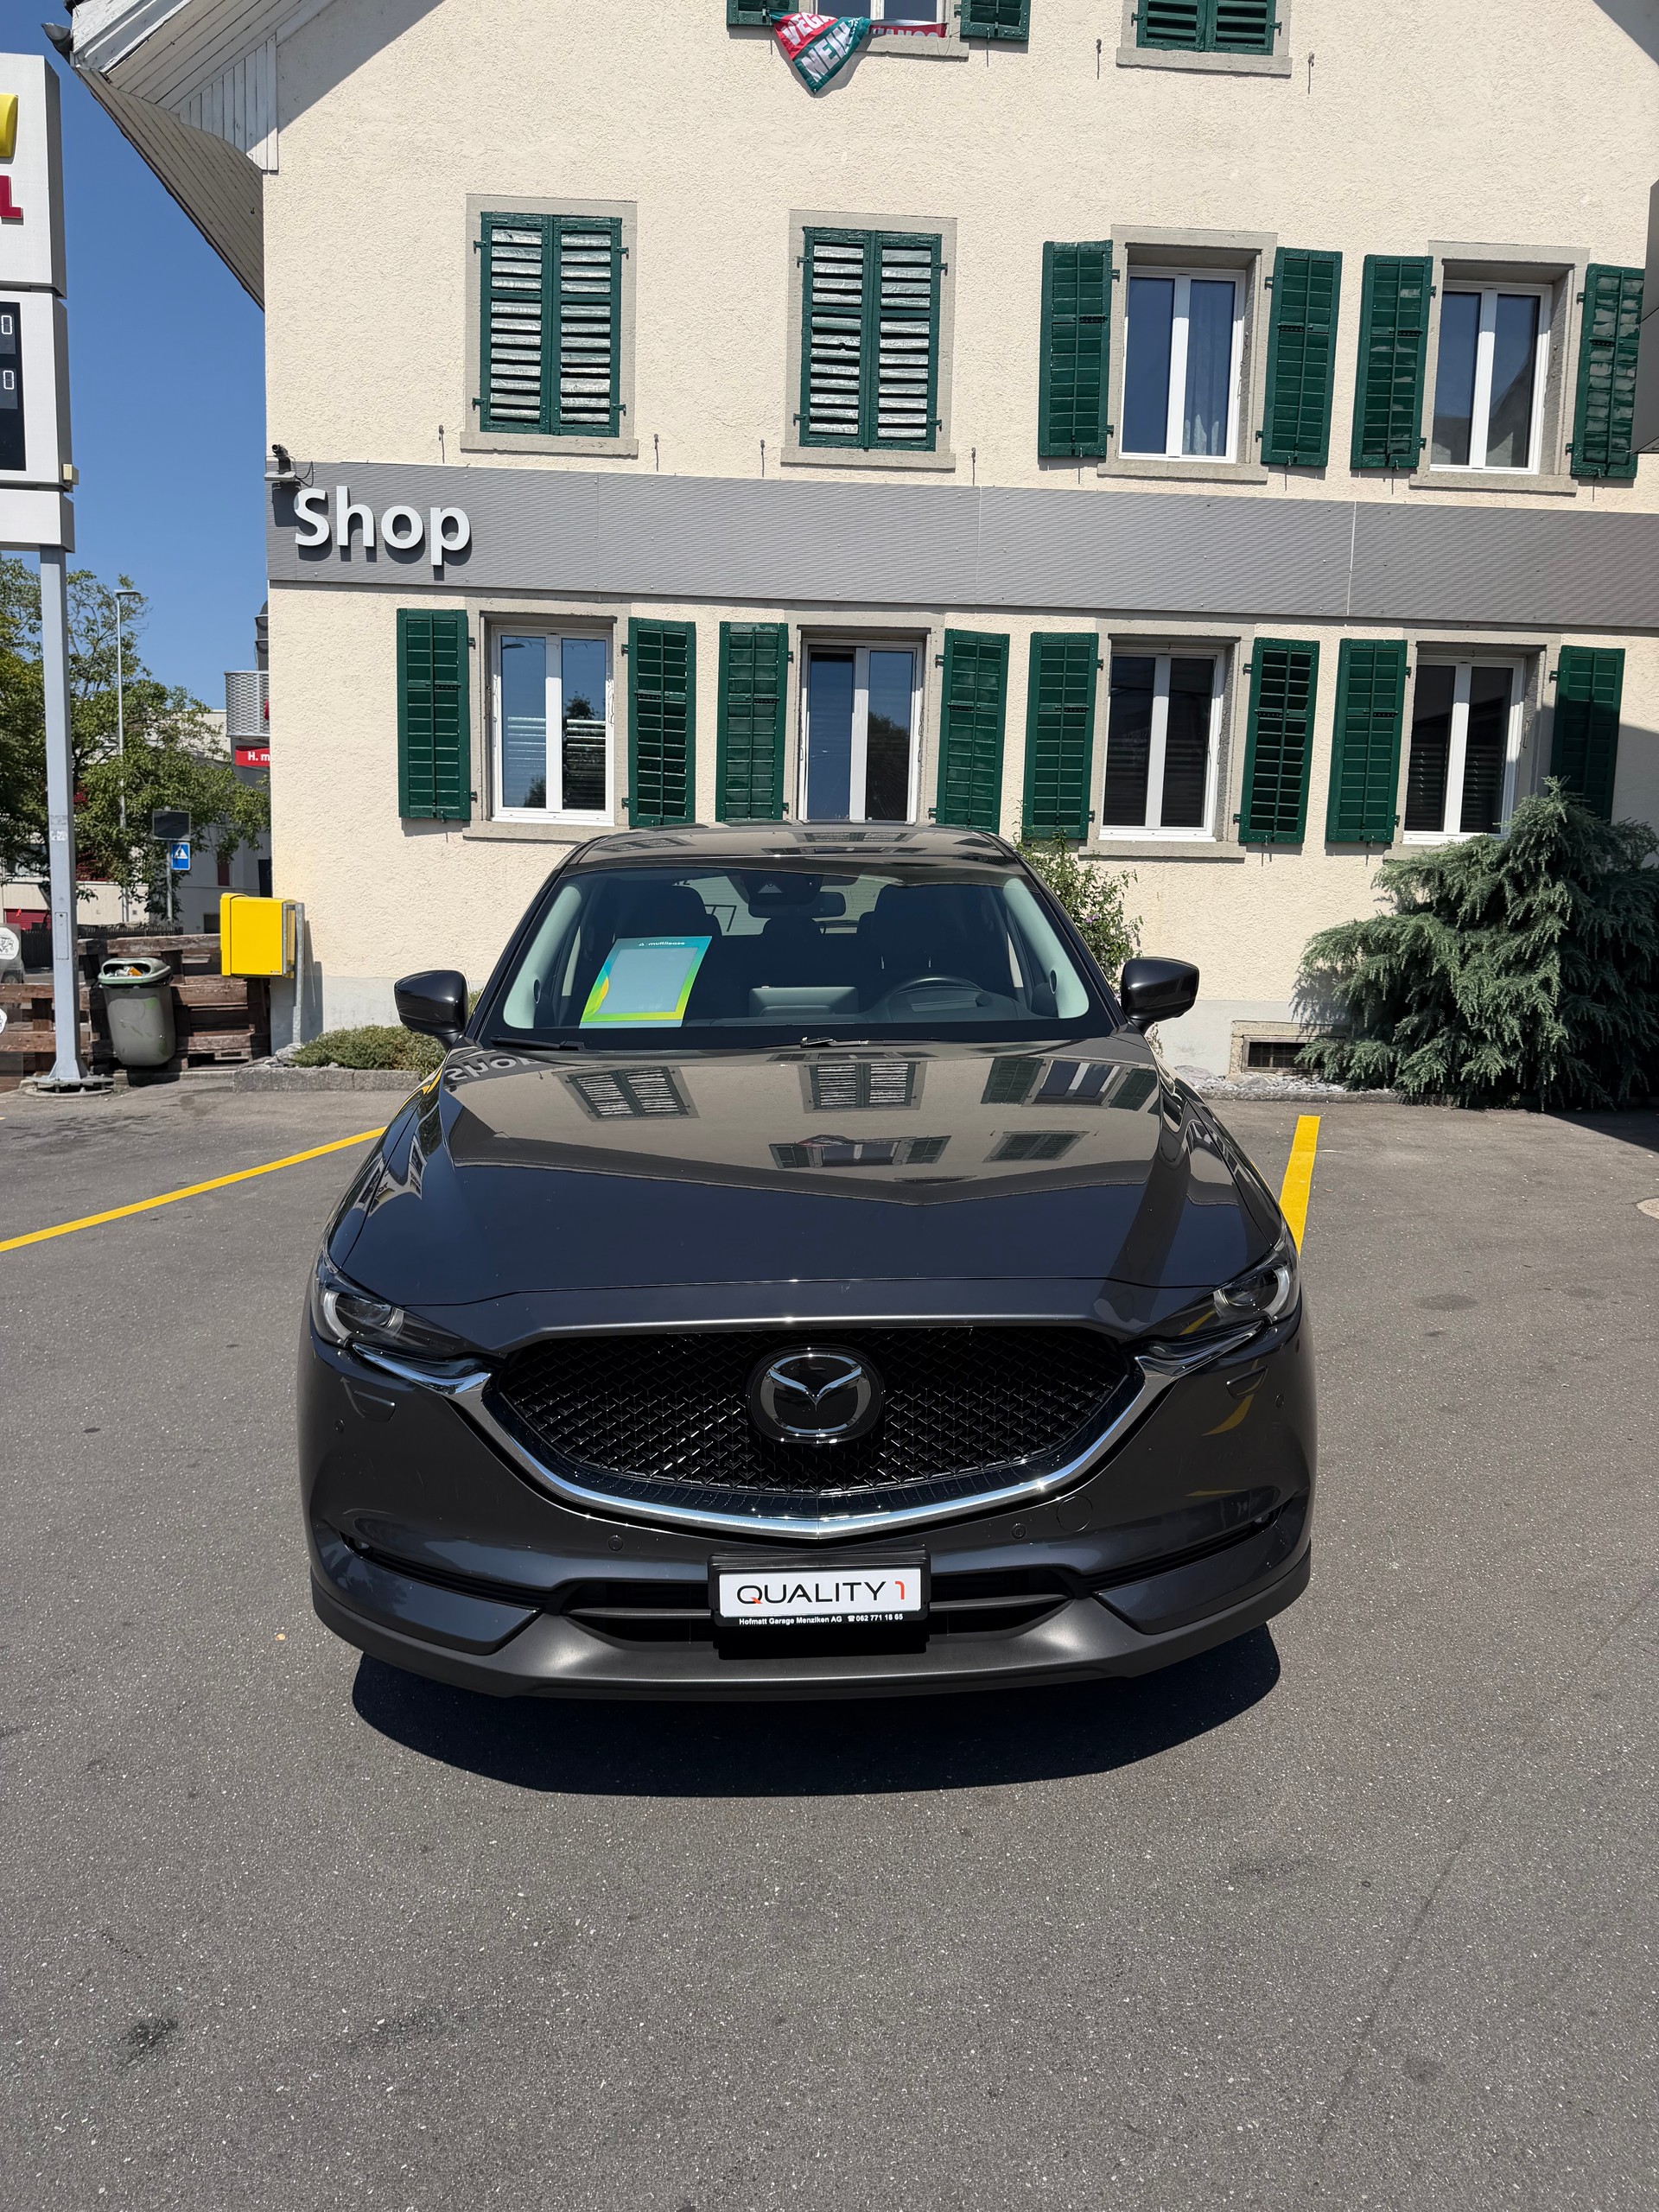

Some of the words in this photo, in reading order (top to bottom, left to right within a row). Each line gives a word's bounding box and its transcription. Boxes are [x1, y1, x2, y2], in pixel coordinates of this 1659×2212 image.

[800, 22, 851, 83] NEIN
[295, 486, 471, 566] Shop
[736, 1580, 887, 1605] QUALITY
[894, 1580, 905, 1600] 1
[796, 1616, 830, 1624] Menziken
